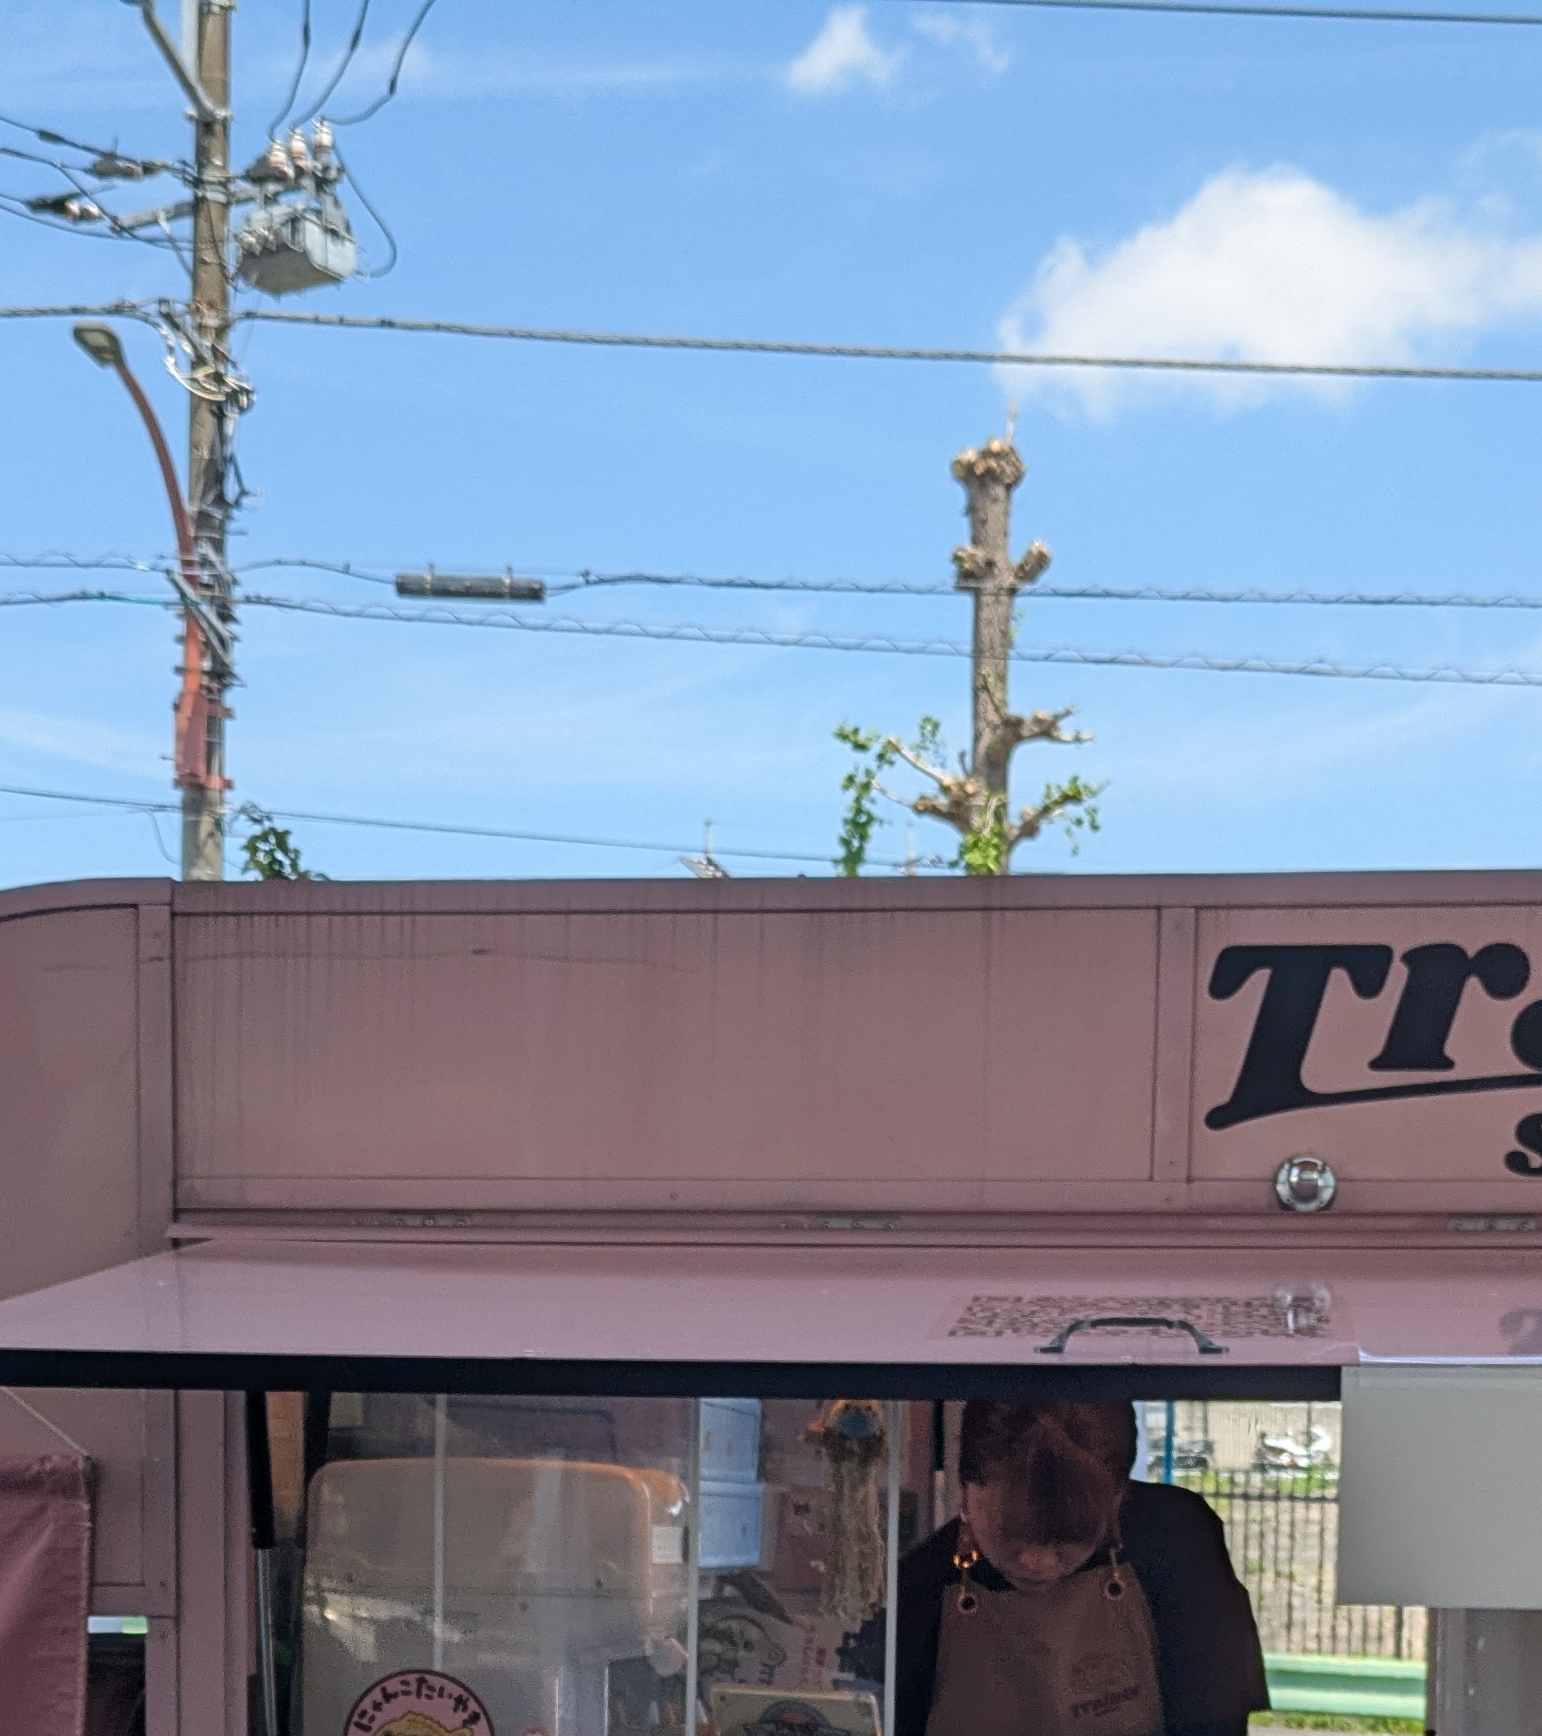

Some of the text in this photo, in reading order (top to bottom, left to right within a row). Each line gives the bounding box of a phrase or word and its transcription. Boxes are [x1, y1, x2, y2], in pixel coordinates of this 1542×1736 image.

[353, 1676, 481, 1733] にゃんこたいやき
